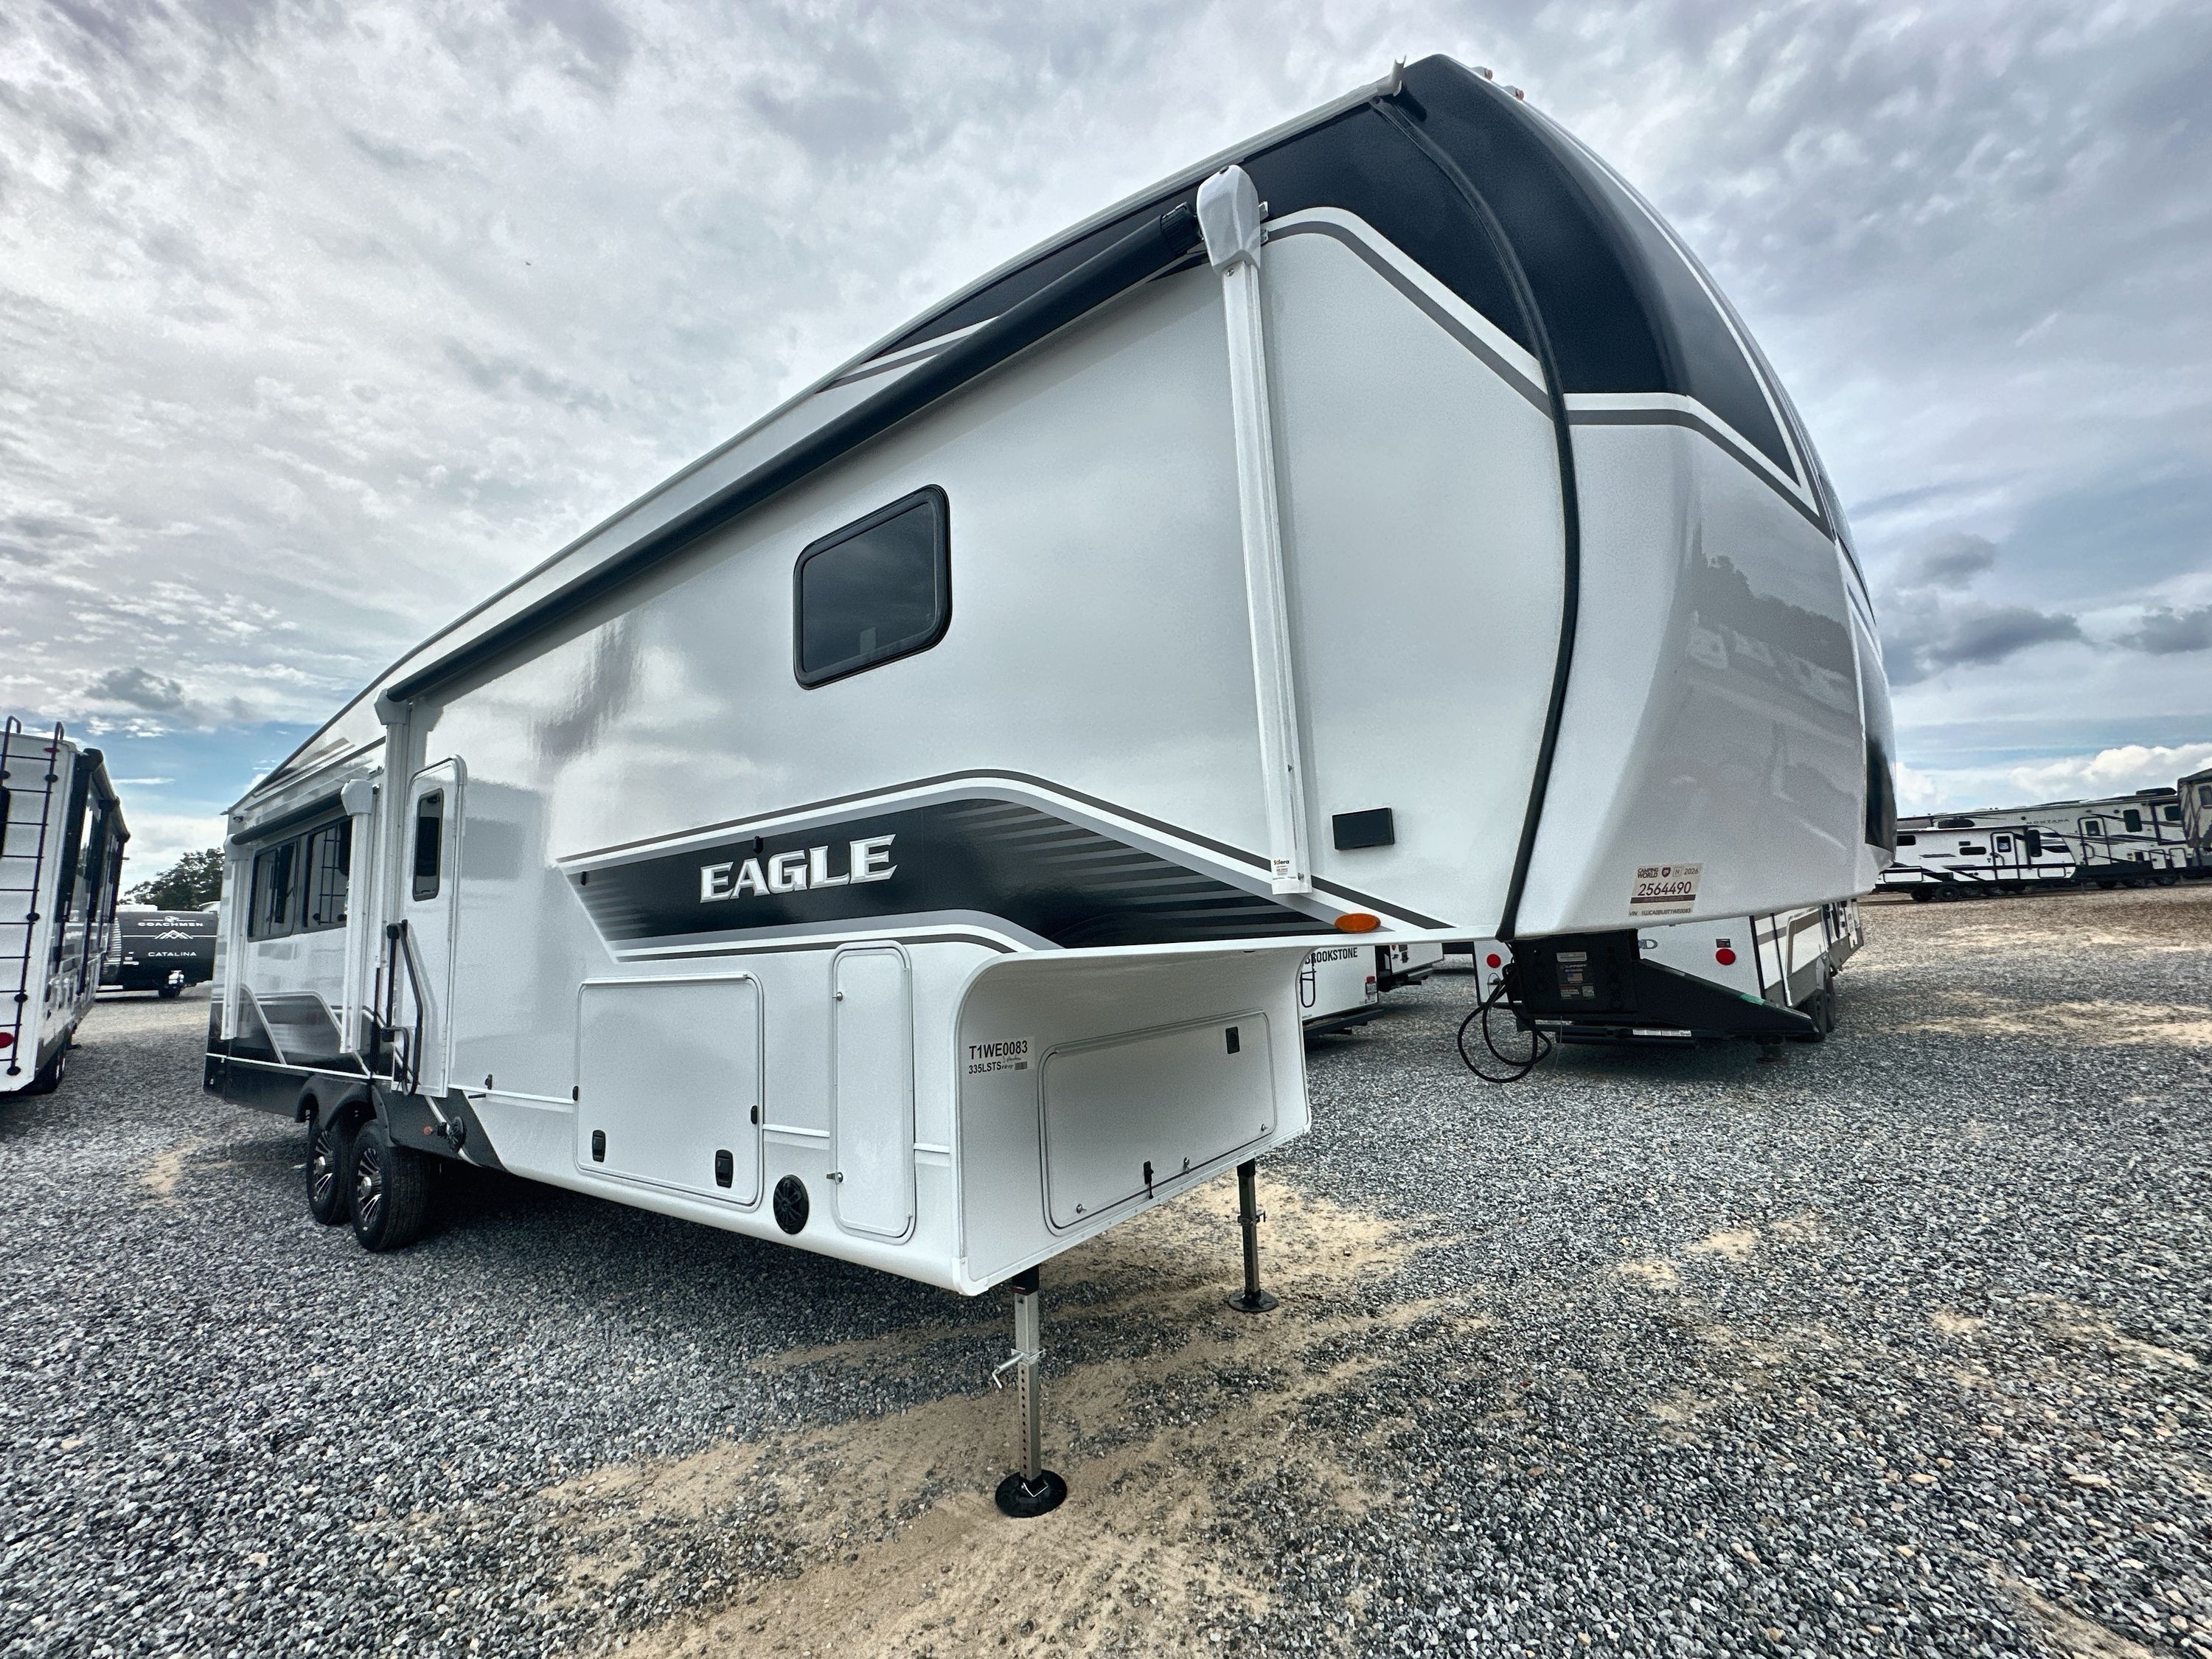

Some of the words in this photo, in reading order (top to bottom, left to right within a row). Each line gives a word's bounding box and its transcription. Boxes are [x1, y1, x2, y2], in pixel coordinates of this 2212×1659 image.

[700, 833, 898, 903] EAGLE
[1637, 881, 1692, 896] 2564490
[968, 1040, 1029, 1060] T1WE0083
[968, 1061, 1002, 1075] 335LSTS
